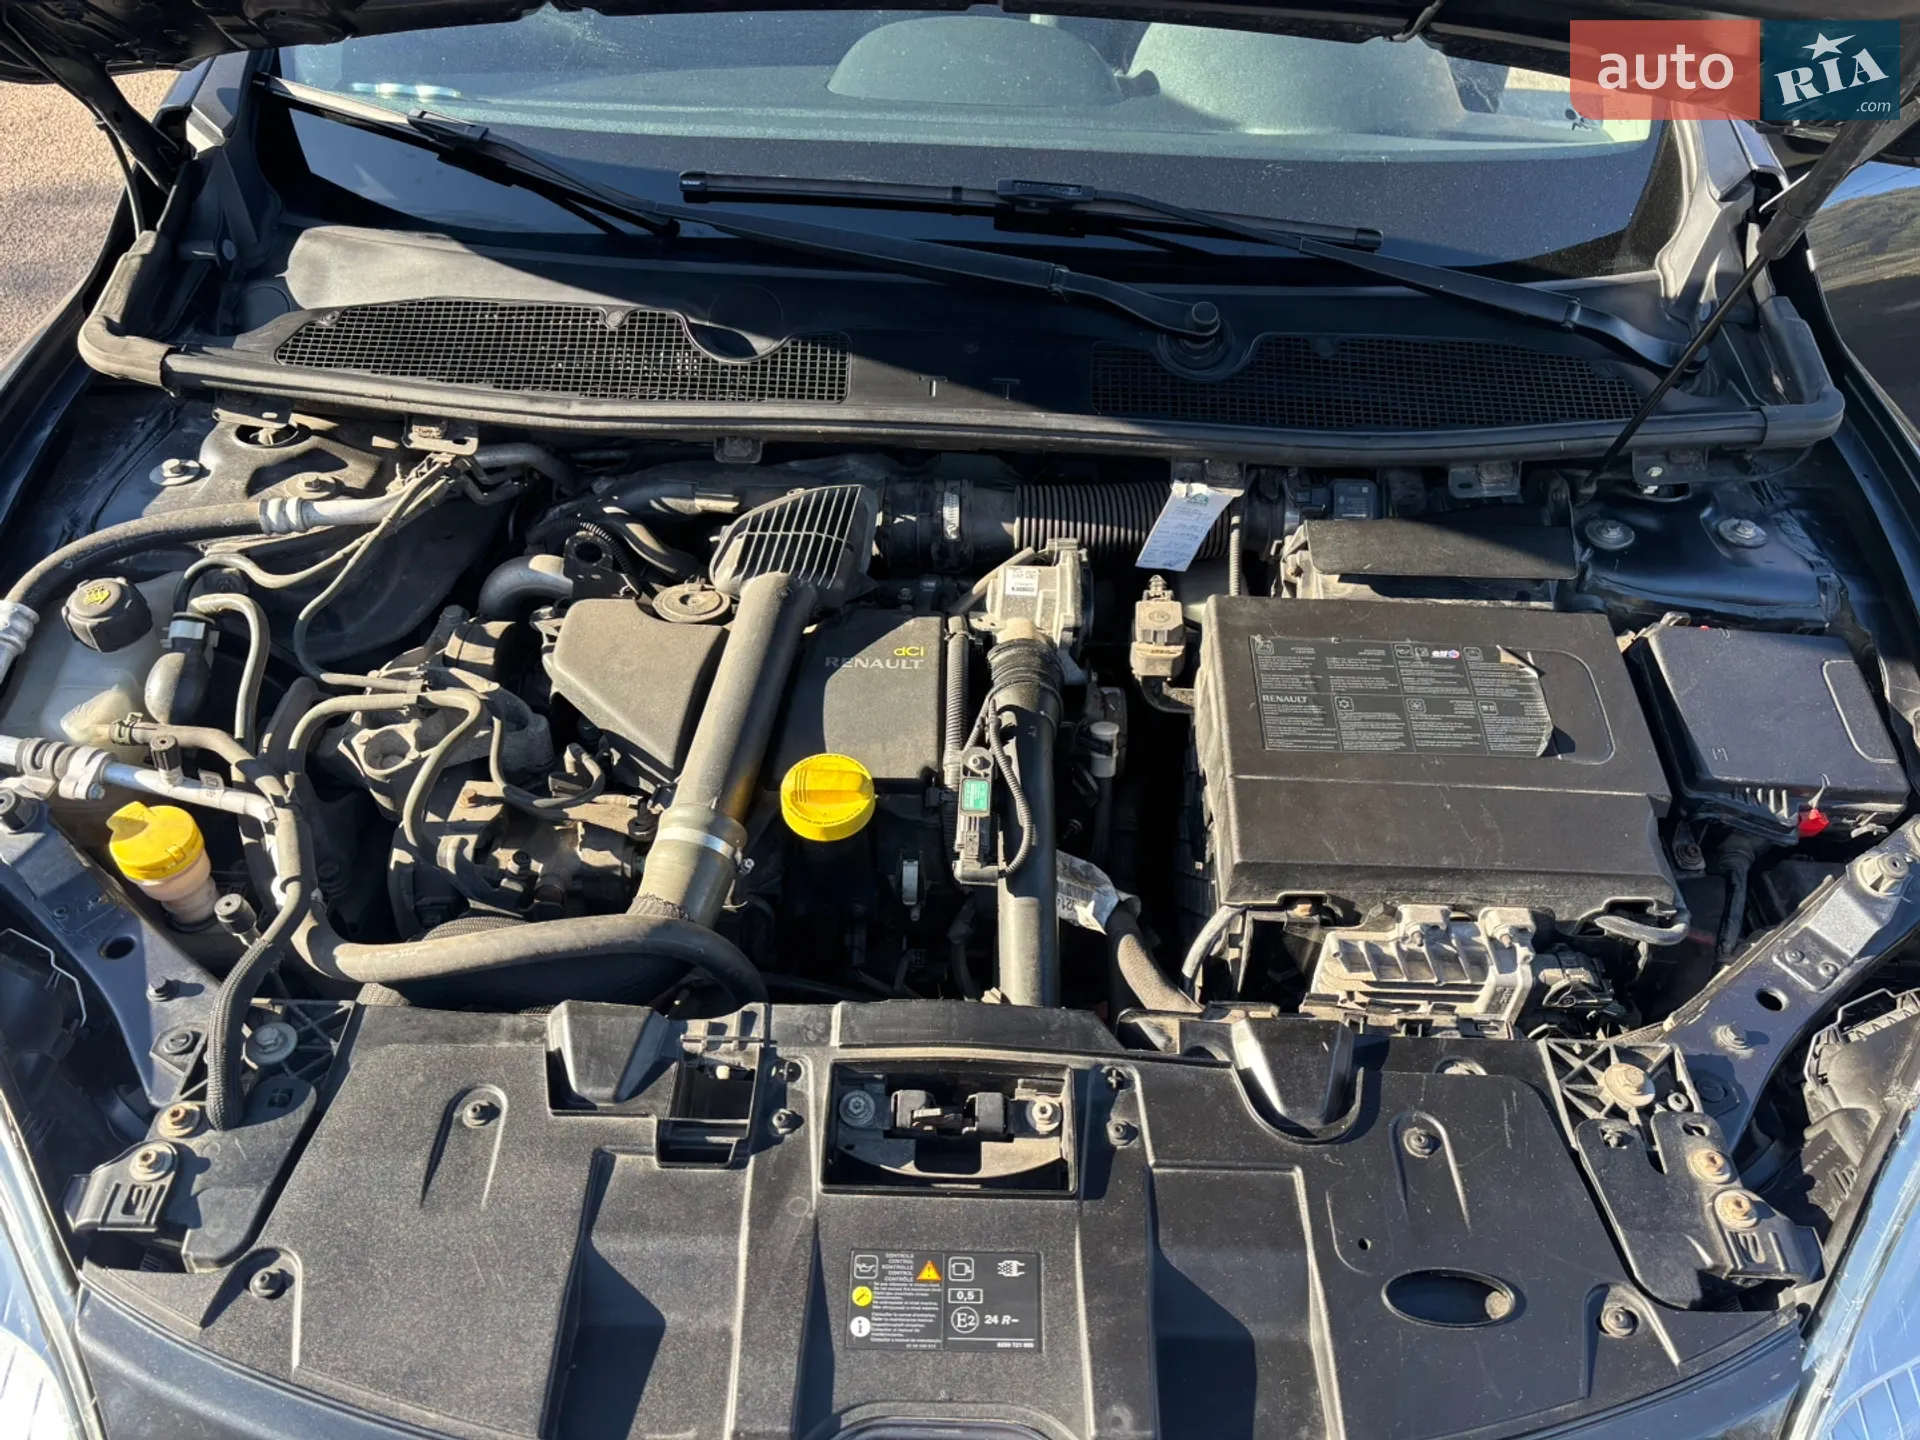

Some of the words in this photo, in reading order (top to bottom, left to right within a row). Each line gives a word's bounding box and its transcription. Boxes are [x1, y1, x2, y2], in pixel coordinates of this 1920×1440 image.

[825, 656, 924, 670] RENAULT
[1262, 694, 1308, 704] RENAULT
[956, 1290, 975, 1302] 0,5
[956, 1313, 976, 1328] E2
[984, 1314, 999, 1325] 24
